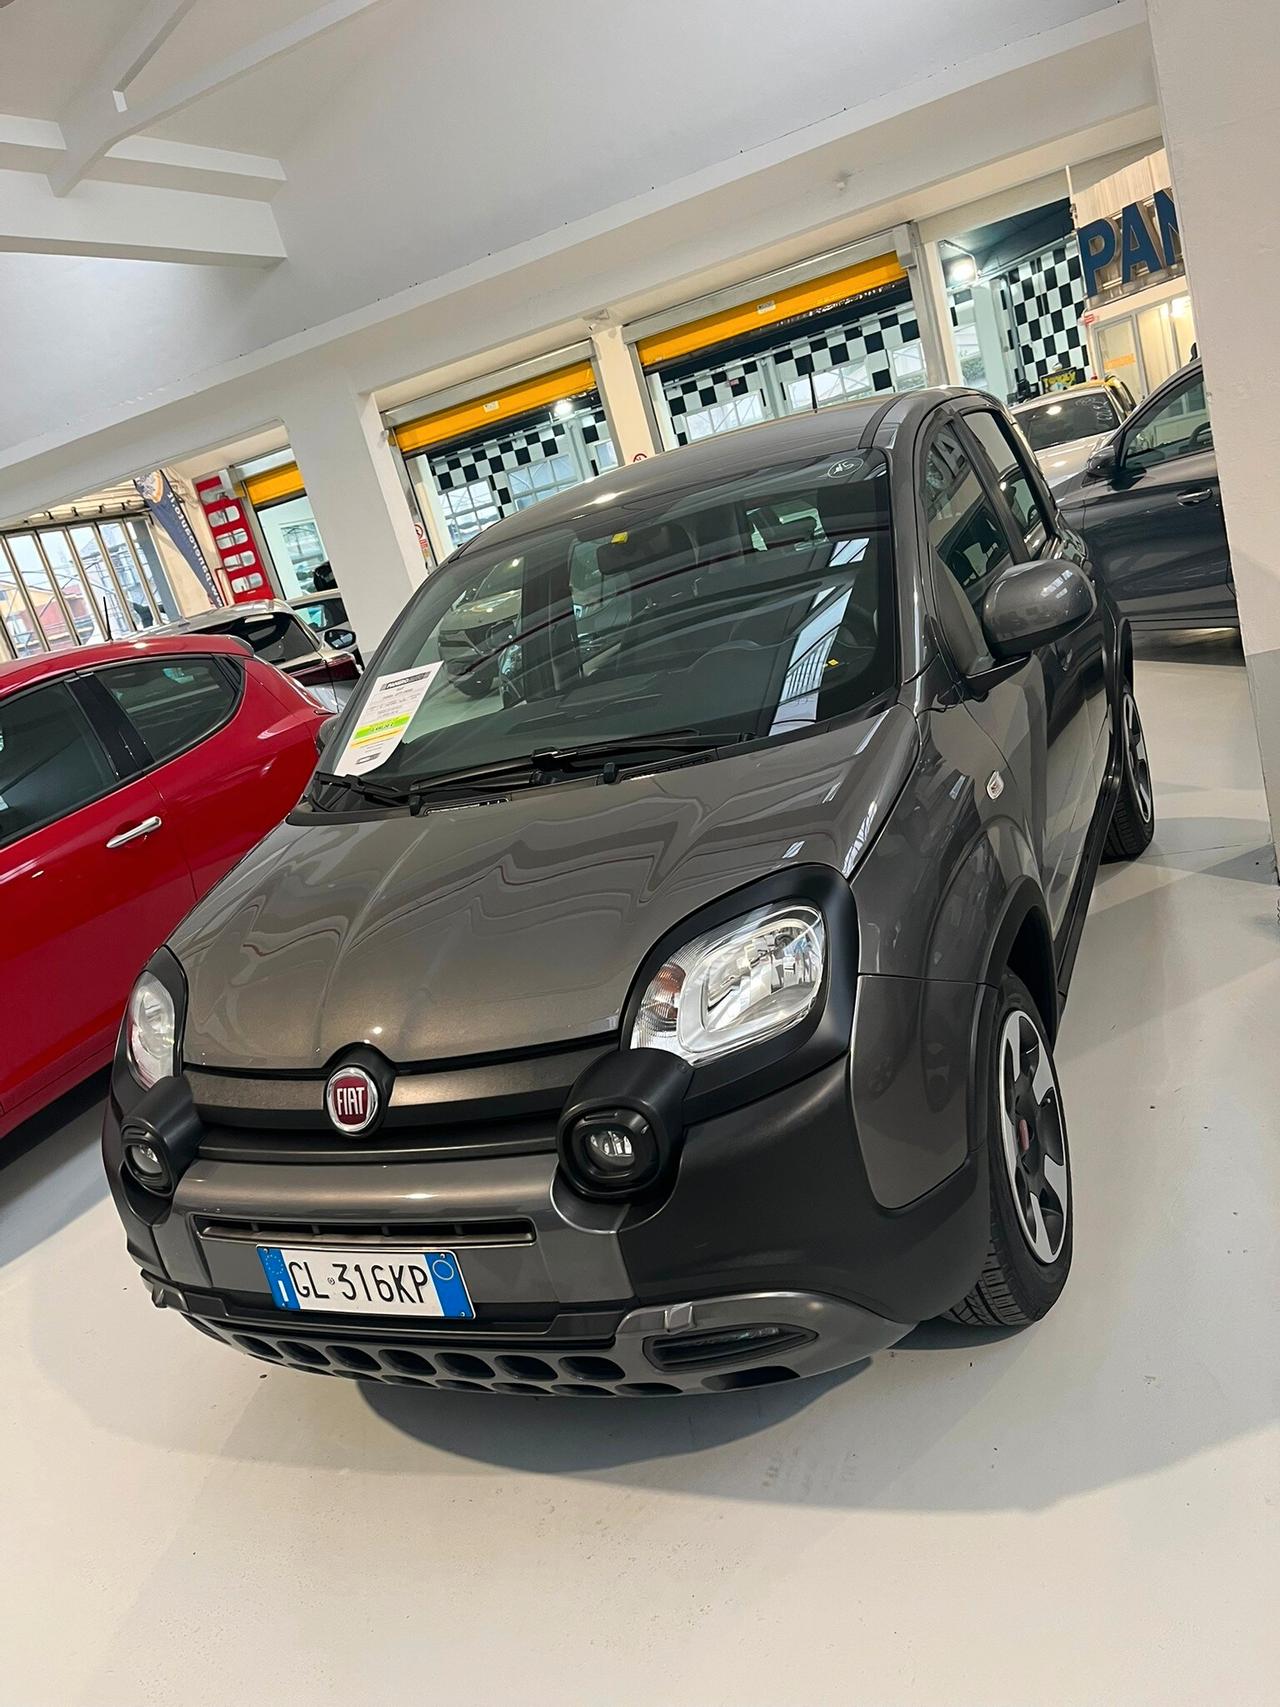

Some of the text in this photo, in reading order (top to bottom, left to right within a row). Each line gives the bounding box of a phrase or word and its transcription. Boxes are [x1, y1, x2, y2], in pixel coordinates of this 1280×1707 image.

[336, 1087, 365, 1115] FIAT
[289, 1262, 330, 1298] GL
[332, 1263, 428, 1304] 316KP
